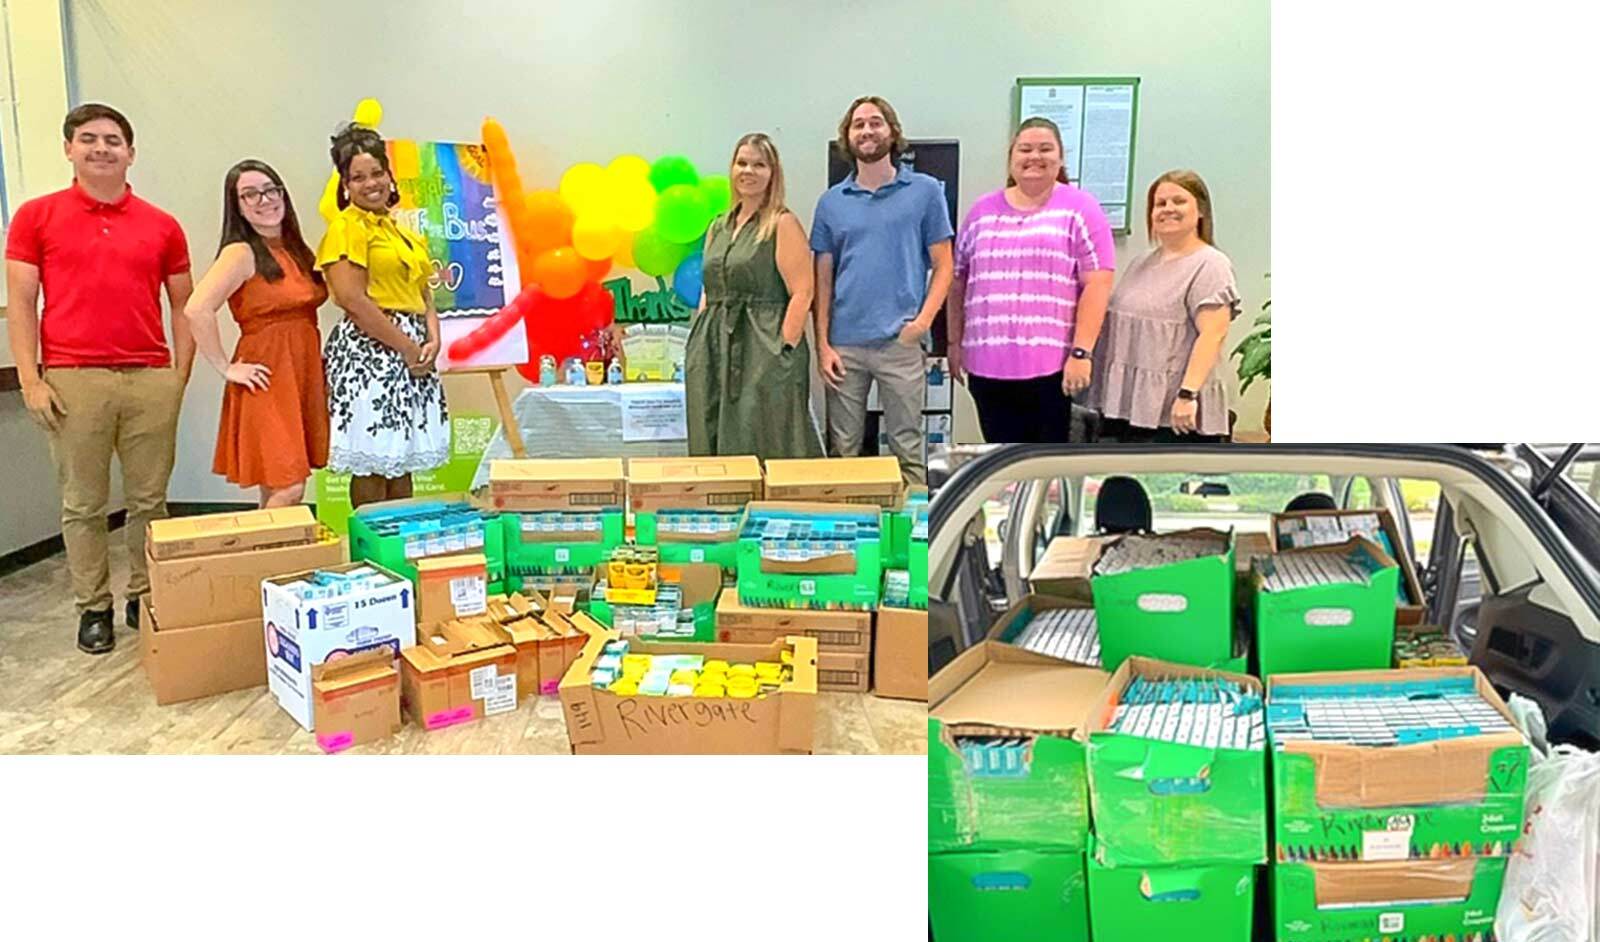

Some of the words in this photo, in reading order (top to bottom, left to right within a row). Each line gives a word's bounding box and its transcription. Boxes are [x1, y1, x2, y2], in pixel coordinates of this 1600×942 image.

[602, 275, 691, 323] Thanks
[355, 599, 367, 609] 15
[615, 696, 757, 741] Rivergate
[1480, 823, 1517, 834] Crayons
